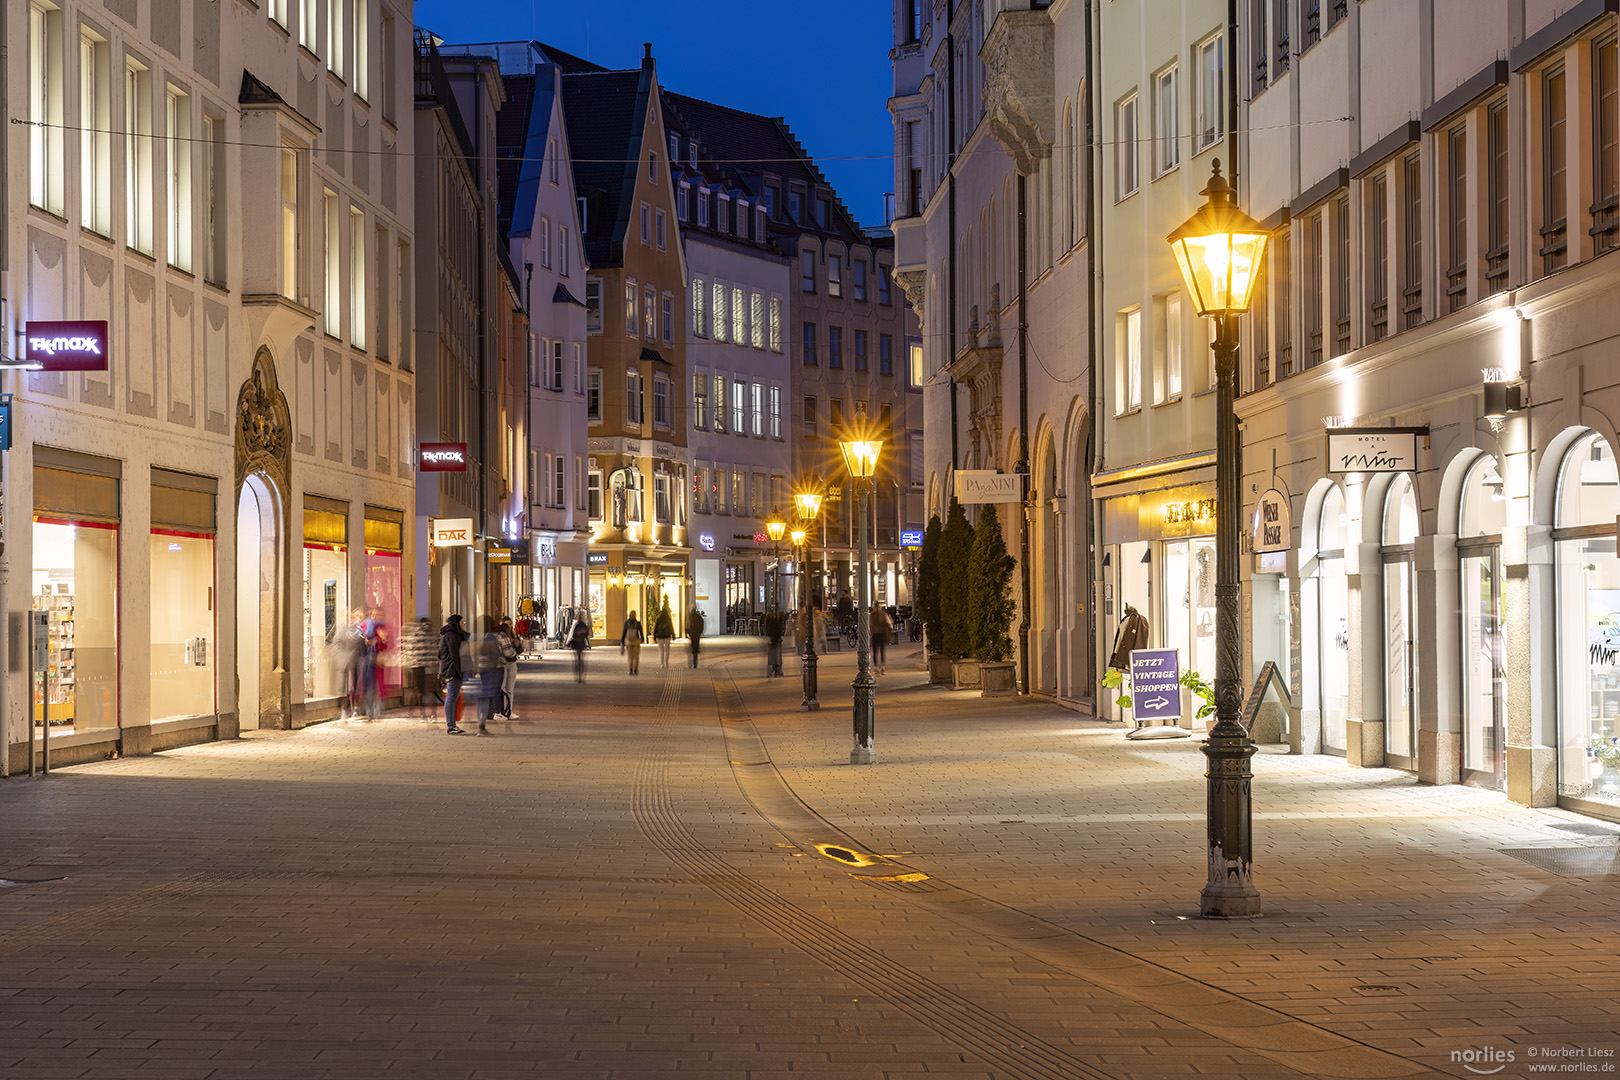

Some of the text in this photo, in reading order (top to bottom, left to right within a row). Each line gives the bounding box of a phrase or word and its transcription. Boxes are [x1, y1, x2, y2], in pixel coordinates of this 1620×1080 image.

[438, 529, 467, 541] DAK
[1133, 658, 1165, 668] JETZT
[1134, 670, 1175, 680] VINTAGE
[1135, 683, 1178, 693] SHOPPEN
